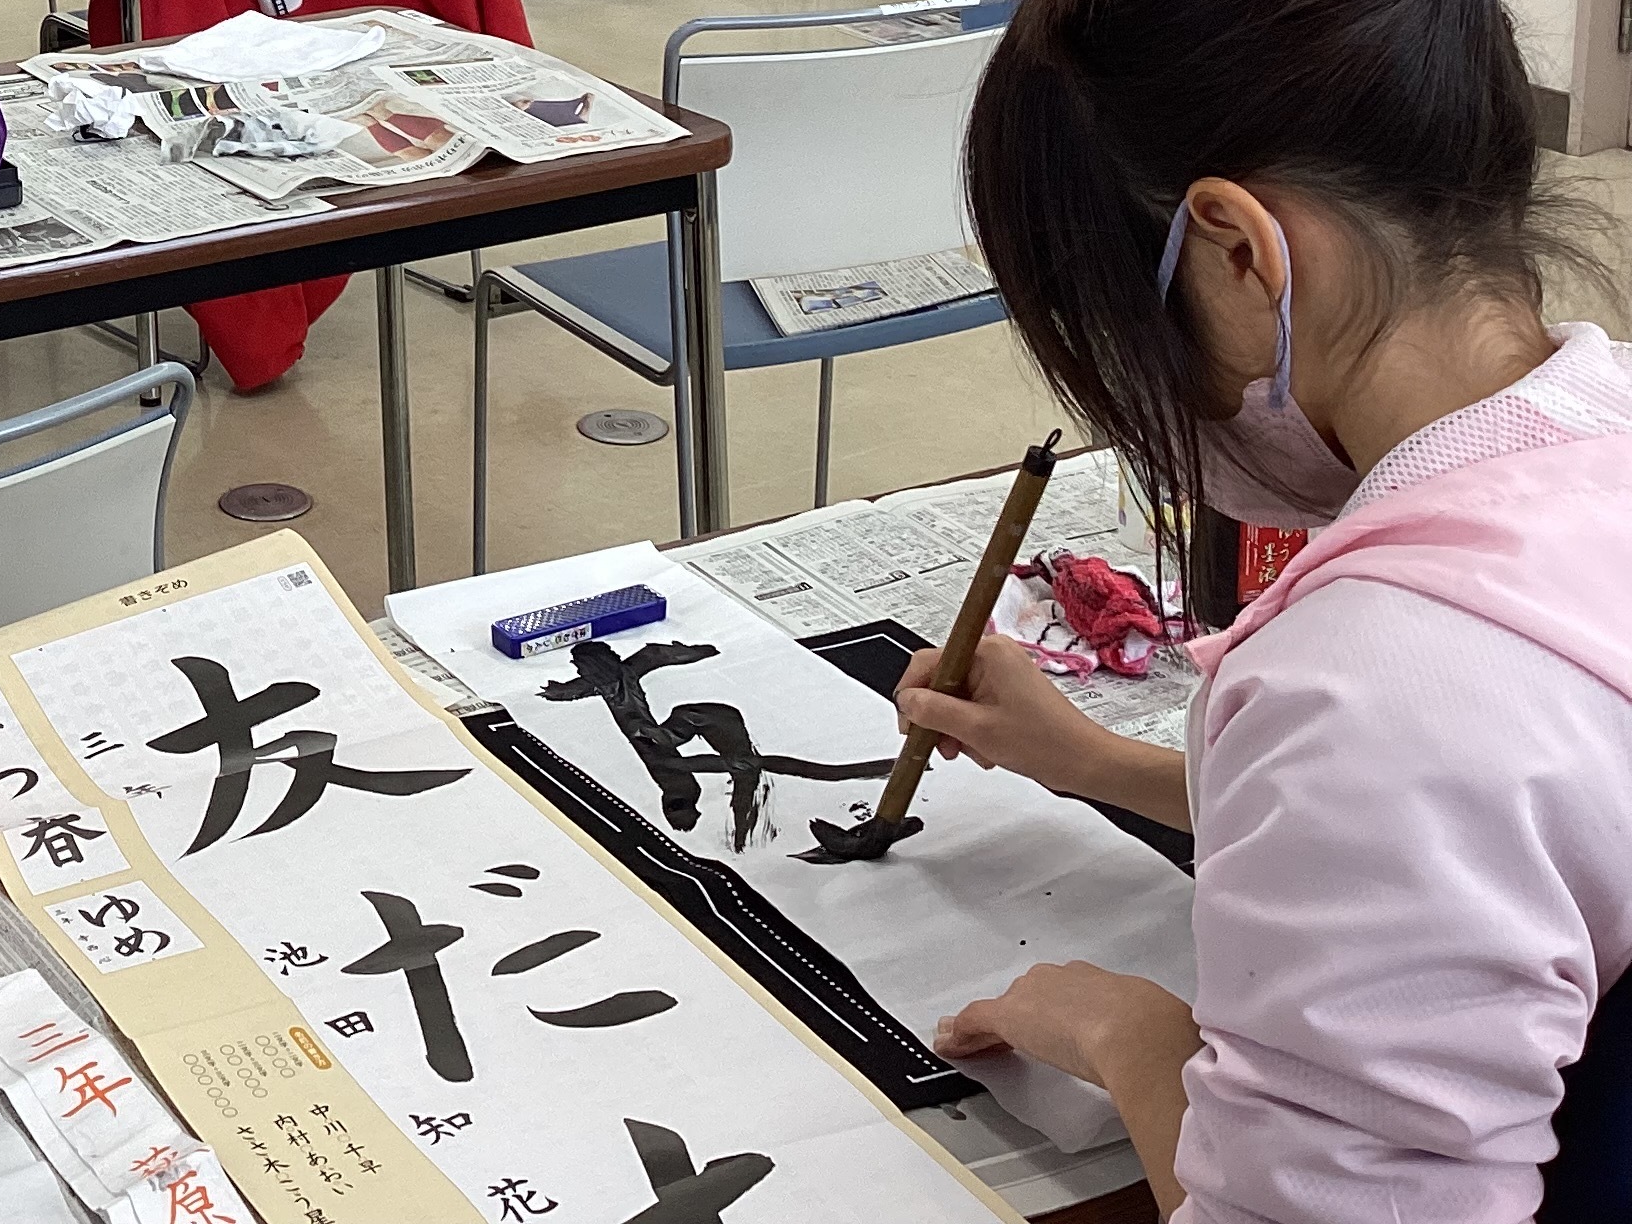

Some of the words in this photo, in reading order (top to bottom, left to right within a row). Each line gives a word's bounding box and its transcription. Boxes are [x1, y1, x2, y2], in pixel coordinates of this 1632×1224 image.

[1258, 541, 1278, 584] 墨液
[118, 579, 188, 608] 書きぞめ
[78, 894, 171, 958] ゆめ
[18, 1022, 133, 1118] 三年
